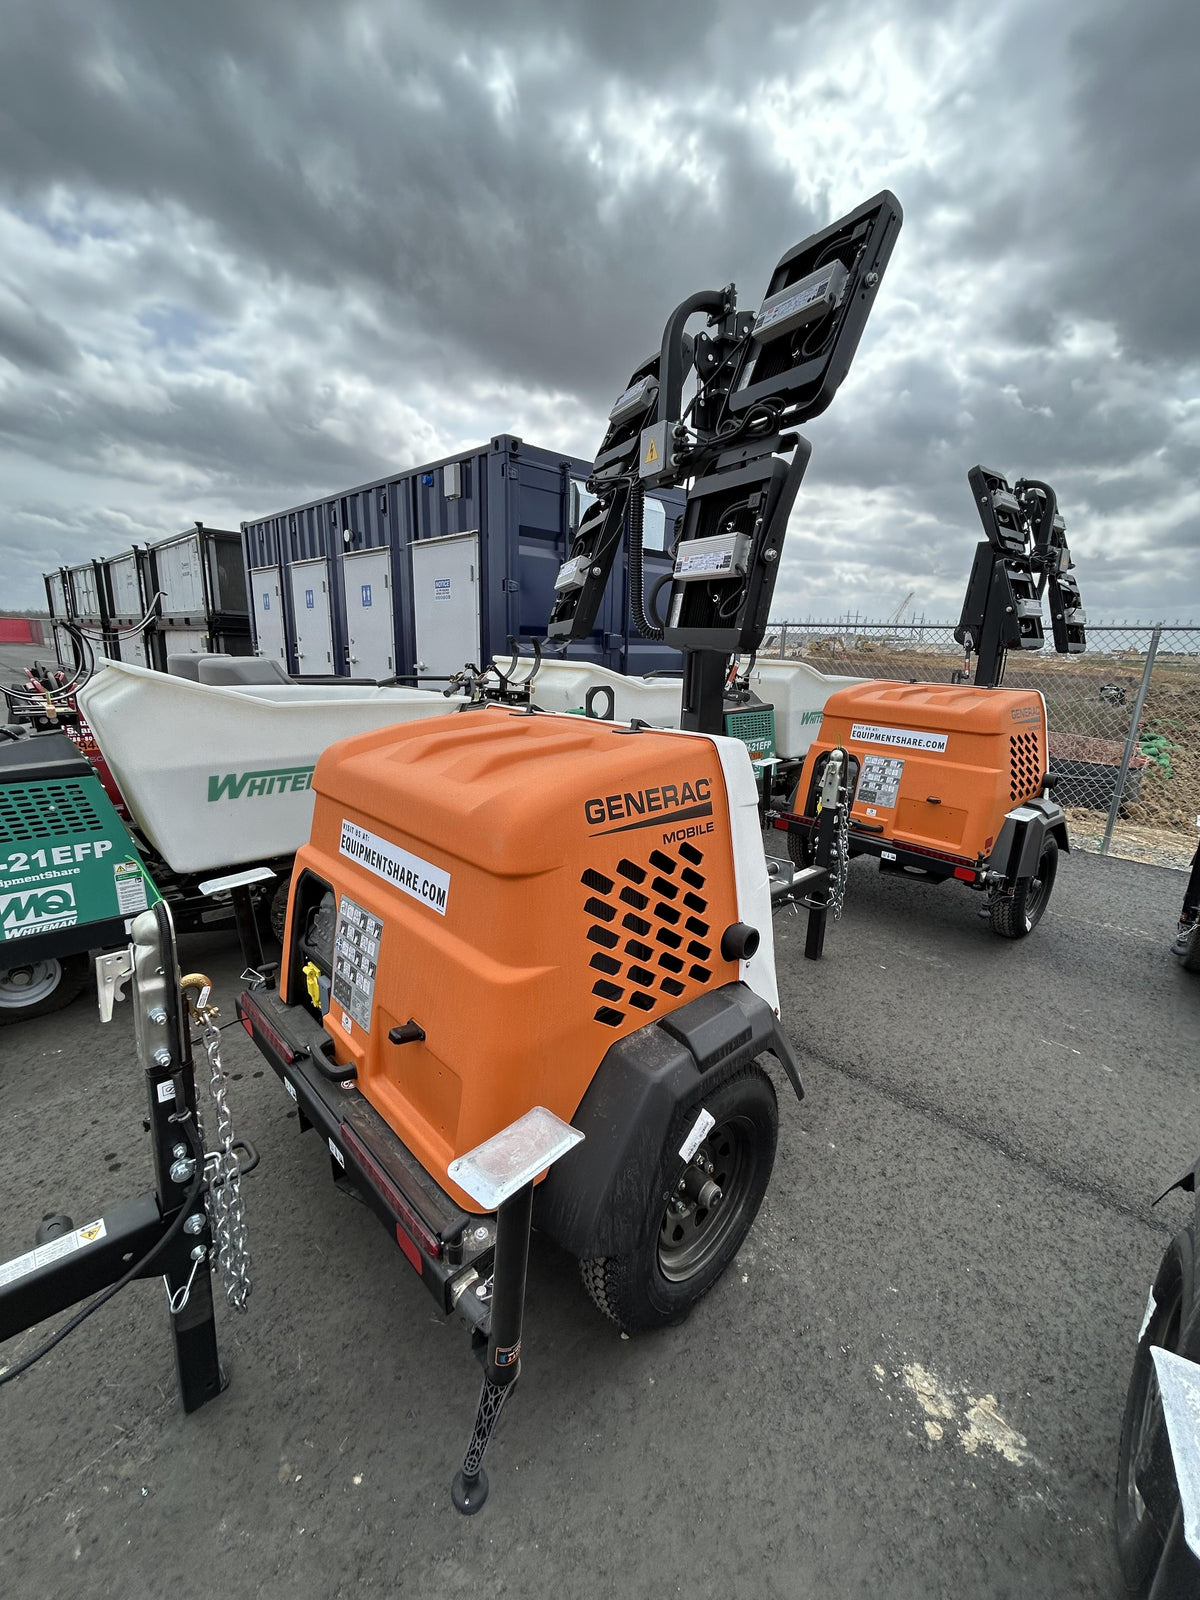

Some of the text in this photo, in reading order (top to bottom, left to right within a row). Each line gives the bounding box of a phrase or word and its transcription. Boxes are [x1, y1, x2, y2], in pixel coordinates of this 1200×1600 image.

[851, 730, 945, 750] EQUIPMENTSHARE.COM
[584, 778, 711, 825] GENERAC
[343, 823, 354, 834] VISIT
[355, 829, 361, 838] US
[662, 821, 714, 845] MOBILE
[0, 867, 81, 888] ipmentShare
[340, 834, 447, 908] EQUIPMENTSHARE.COM
[4, 917, 78, 940] WHITEMAN
